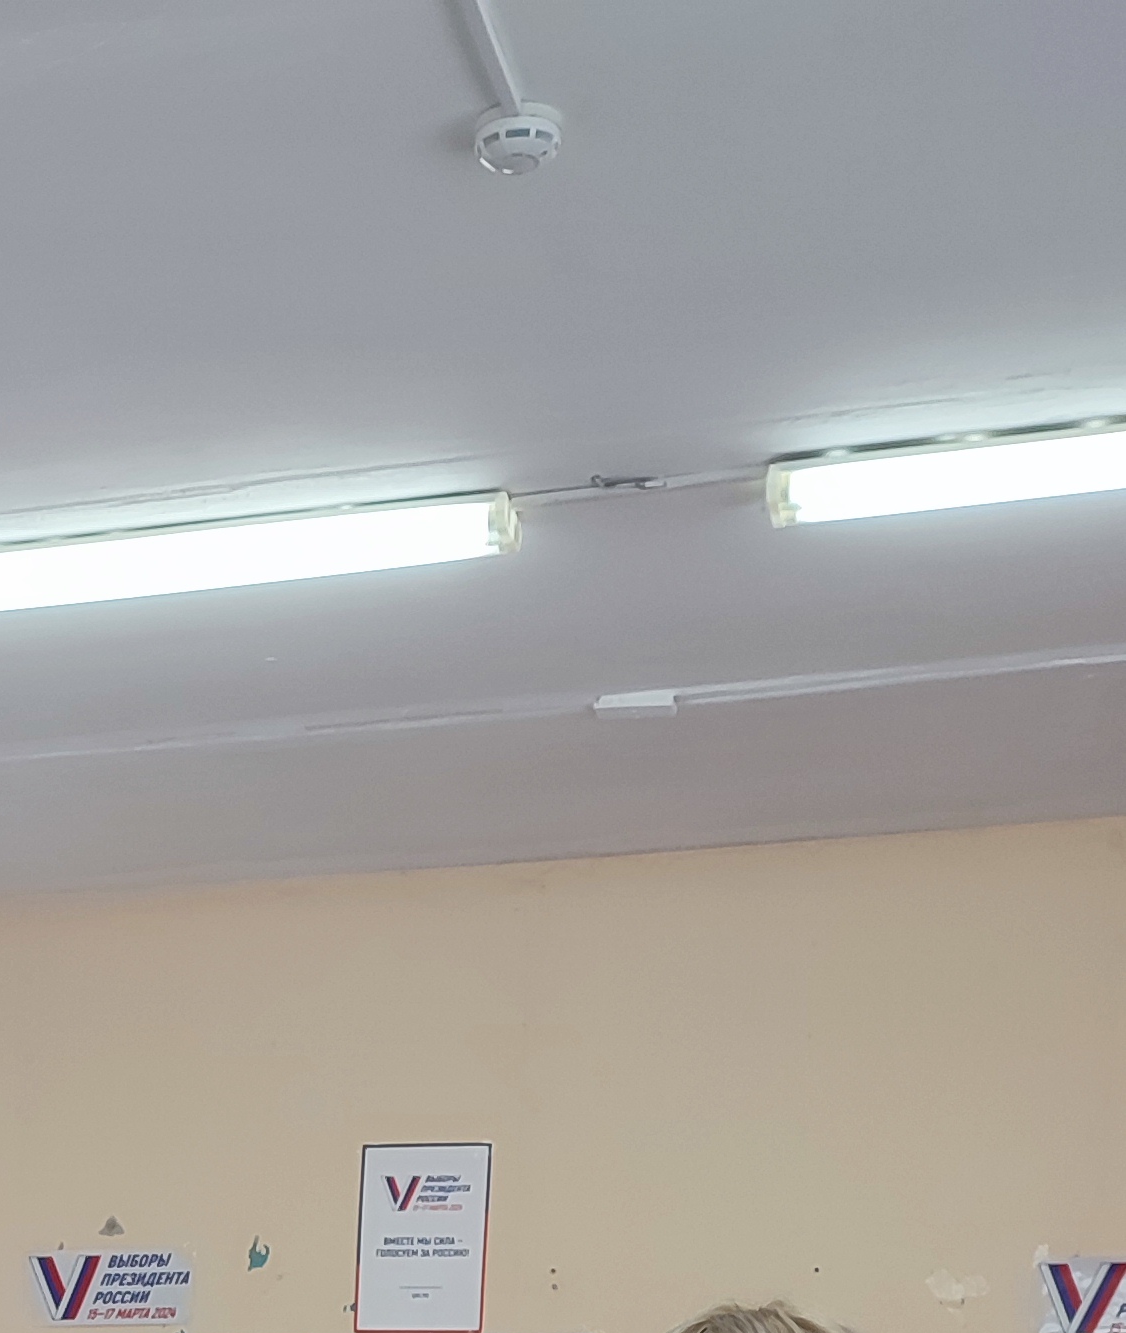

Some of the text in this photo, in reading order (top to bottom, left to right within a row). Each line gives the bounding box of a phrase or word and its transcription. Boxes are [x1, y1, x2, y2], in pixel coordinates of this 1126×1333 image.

[383, 1237, 415, 1245] ВМЕСТЕ
[417, 1237, 431, 1245] МЫ
[433, 1237, 455, 1245] СИЛА
[420, 1249, 430, 1257] ЗА
[107, 1253, 172, 1269] ВЫБОРЫ
[100, 1270, 191, 1288] ПРЕЗИДЕНТА
[92, 1290, 151, 1305] РОССИИ
[115, 1307, 150, 1319] МАРТА
[151, 1307, 177, 1320] 2024
